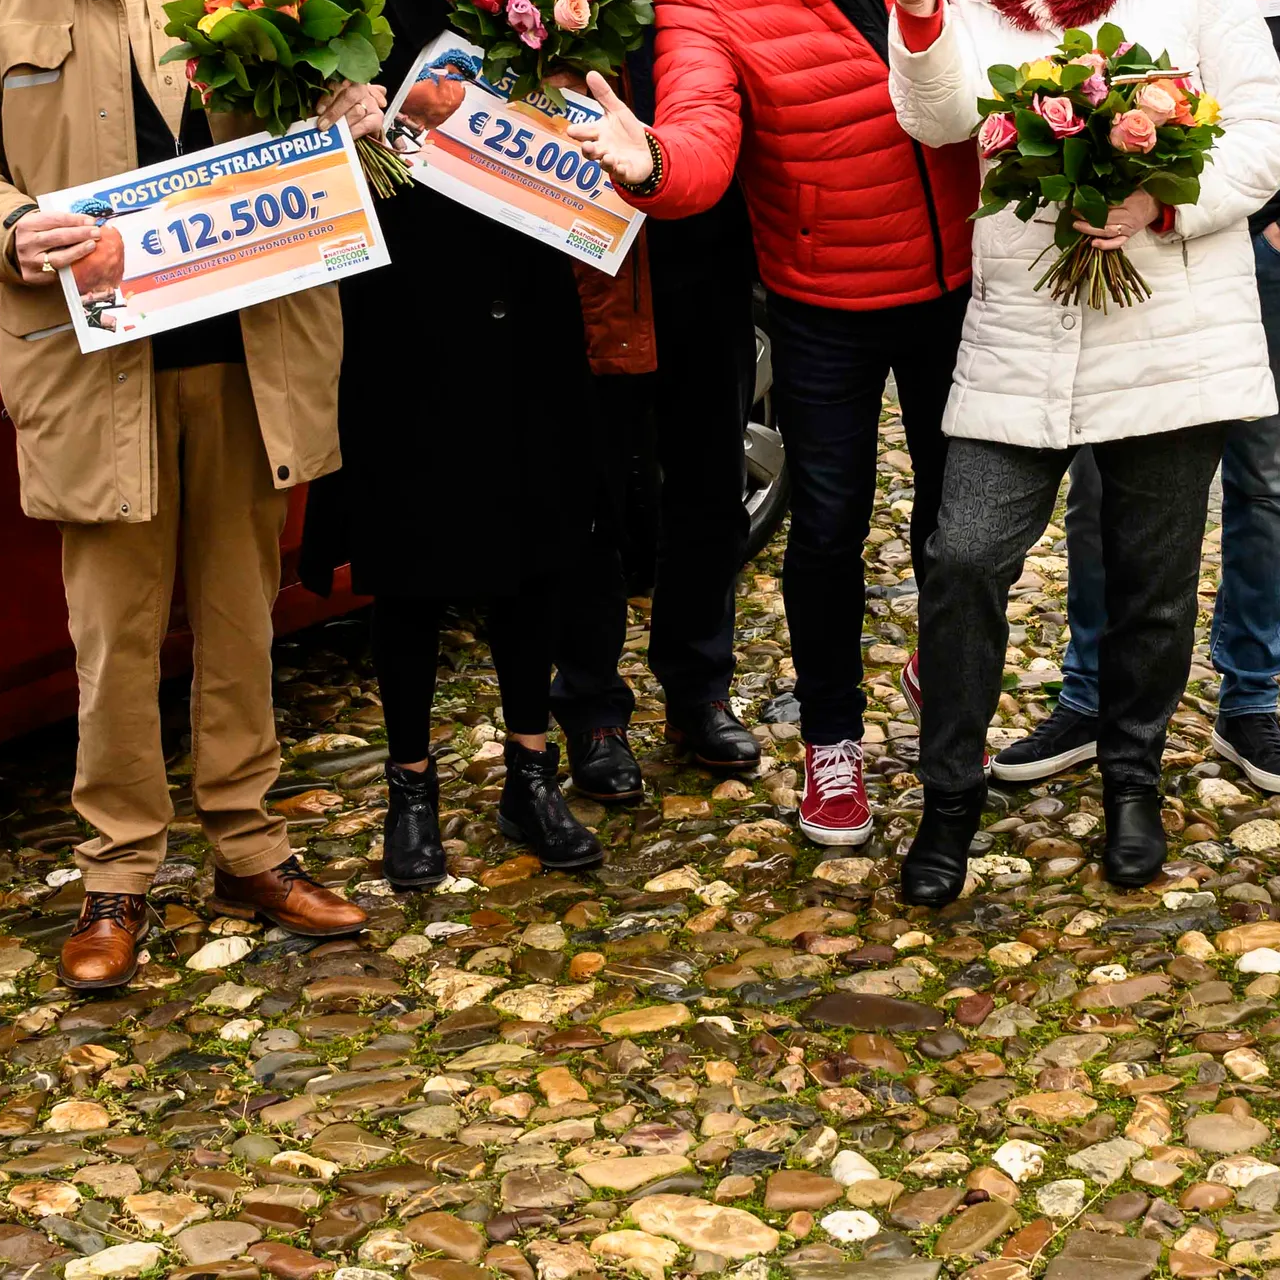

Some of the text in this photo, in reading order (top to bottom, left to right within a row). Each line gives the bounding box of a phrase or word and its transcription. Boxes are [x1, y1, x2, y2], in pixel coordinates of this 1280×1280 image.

[109, 130, 333, 209] POSTCODE STRAATPRIJS
[470, 153, 584, 211] VIJFENTWINTIGDUIZEND EURO
[167, 185, 327, 255] 12.500,-
[568, 232, 606, 255] POSTCODE
[575, 230, 604, 247] NATIONALE
[154, 224, 334, 283] TWAALFDUIZEND VIJFHONDERD EURO
[325, 248, 368, 266] POSTCODE
[328, 244, 361, 258] NATIONALE
[570, 241, 598, 258] LOTERIJ
[332, 257, 365, 270] LOTERIJ
